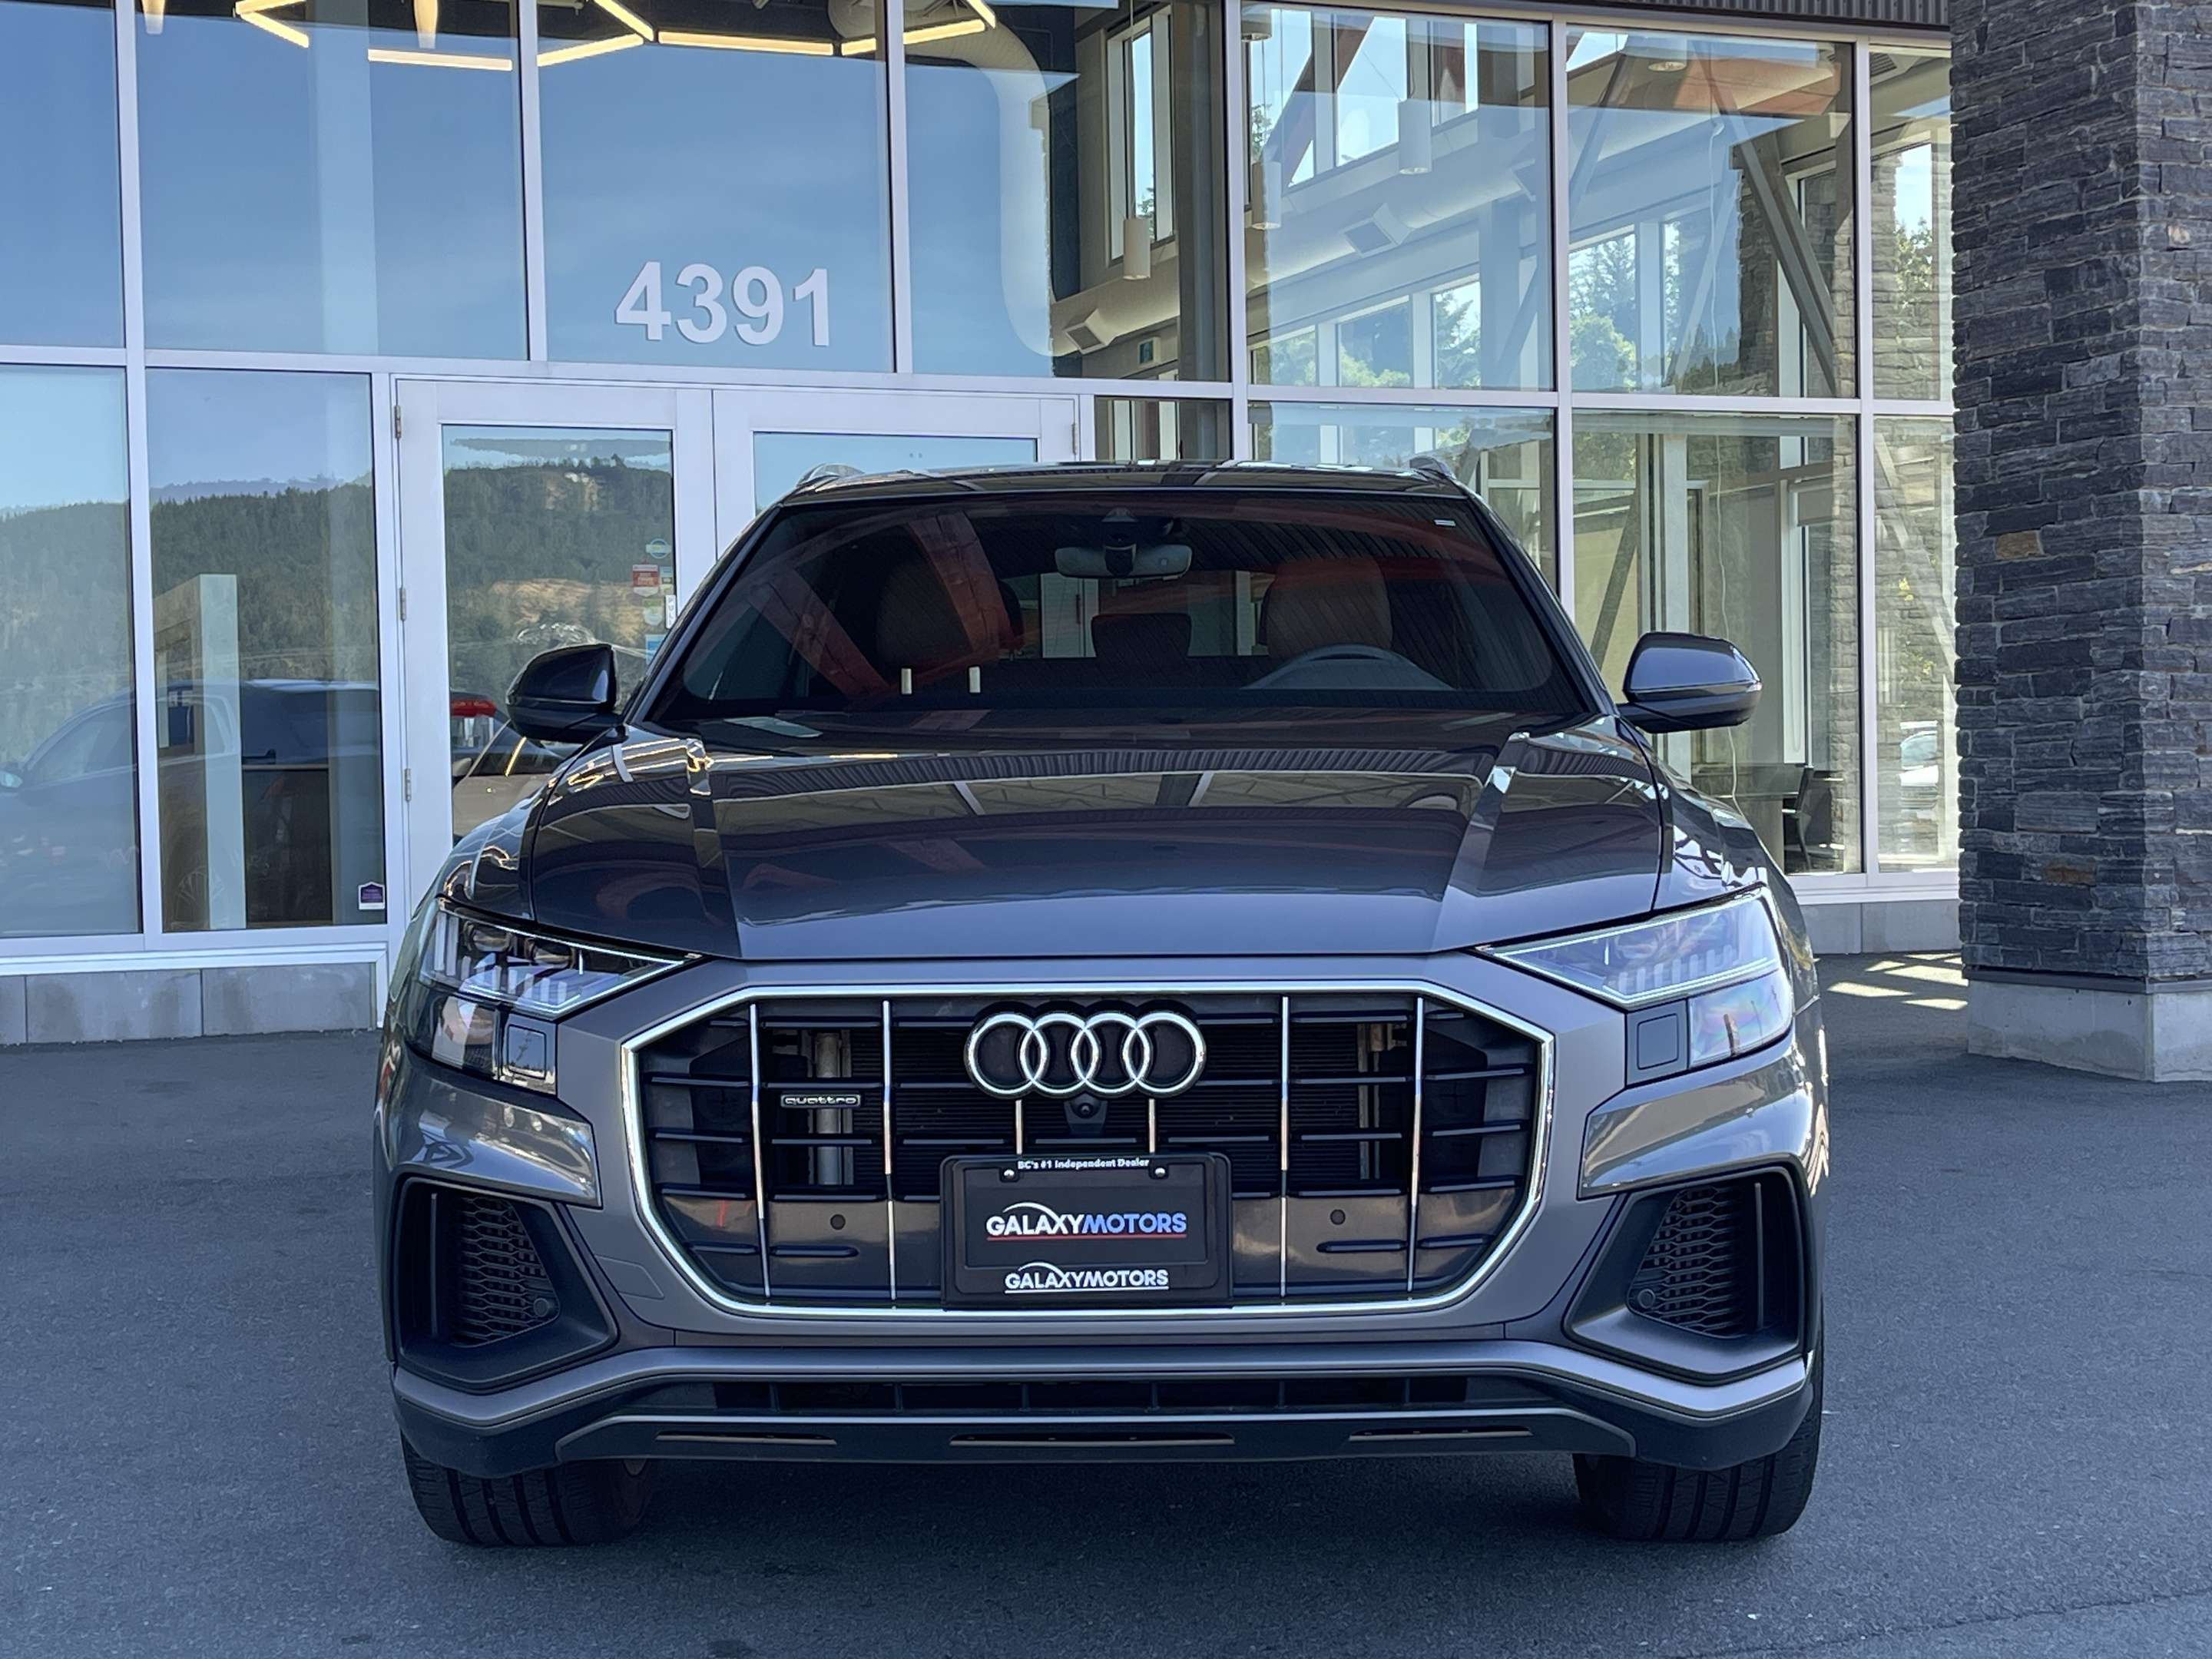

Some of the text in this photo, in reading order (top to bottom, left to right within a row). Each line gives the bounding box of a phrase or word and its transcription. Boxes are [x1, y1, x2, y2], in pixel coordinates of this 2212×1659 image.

[615, 261, 829, 346] 4391
[785, 1097, 856, 1105] quattro
[1018, 1157, 1149, 1170] BC's #1 Independent Dealer
